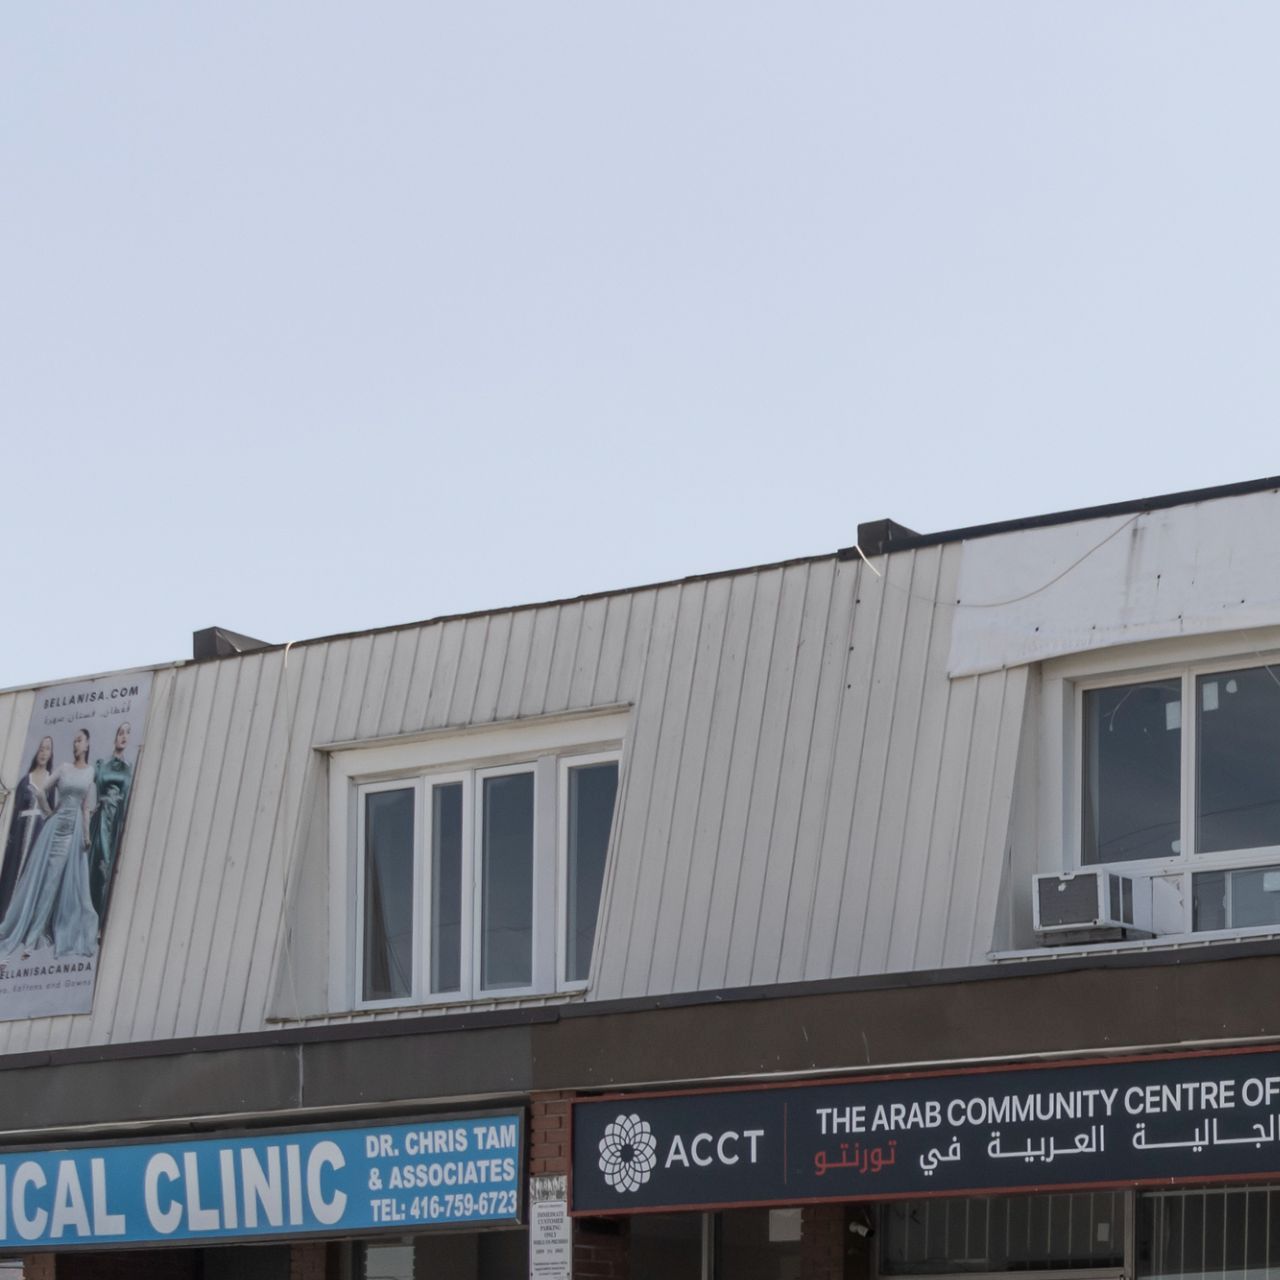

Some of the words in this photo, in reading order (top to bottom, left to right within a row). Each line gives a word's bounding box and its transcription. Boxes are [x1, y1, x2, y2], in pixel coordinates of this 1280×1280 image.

[44, 686, 139, 709] BELLANISA.COM
[816, 1105, 866, 1135] THE
[871, 1099, 942, 1132] ARAB
[947, 1088, 1119, 1126] COMMUNITY
[1124, 1079, 1236, 1115] CENTRE
[1241, 1076, 1280, 1107] OF
[366, 1134, 400, 1158] DR.
[405, 1128, 468, 1155] CHRIS
[473, 1124, 516, 1150] TAM
[665, 1129, 764, 1168] ACCT
[814, 1139, 897, 1176] تورنتو
[920, 1136, 961, 1176] في
[987, 1125, 1104, 1163] العربية
[144, 1140, 348, 1236] CLINIC
[368, 1167, 382, 1190] &
[389, 1158, 515, 1189] ASSOCIATES
[370, 1198, 406, 1222] TEL:
[410, 1190, 517, 1219] 416-759-6723
